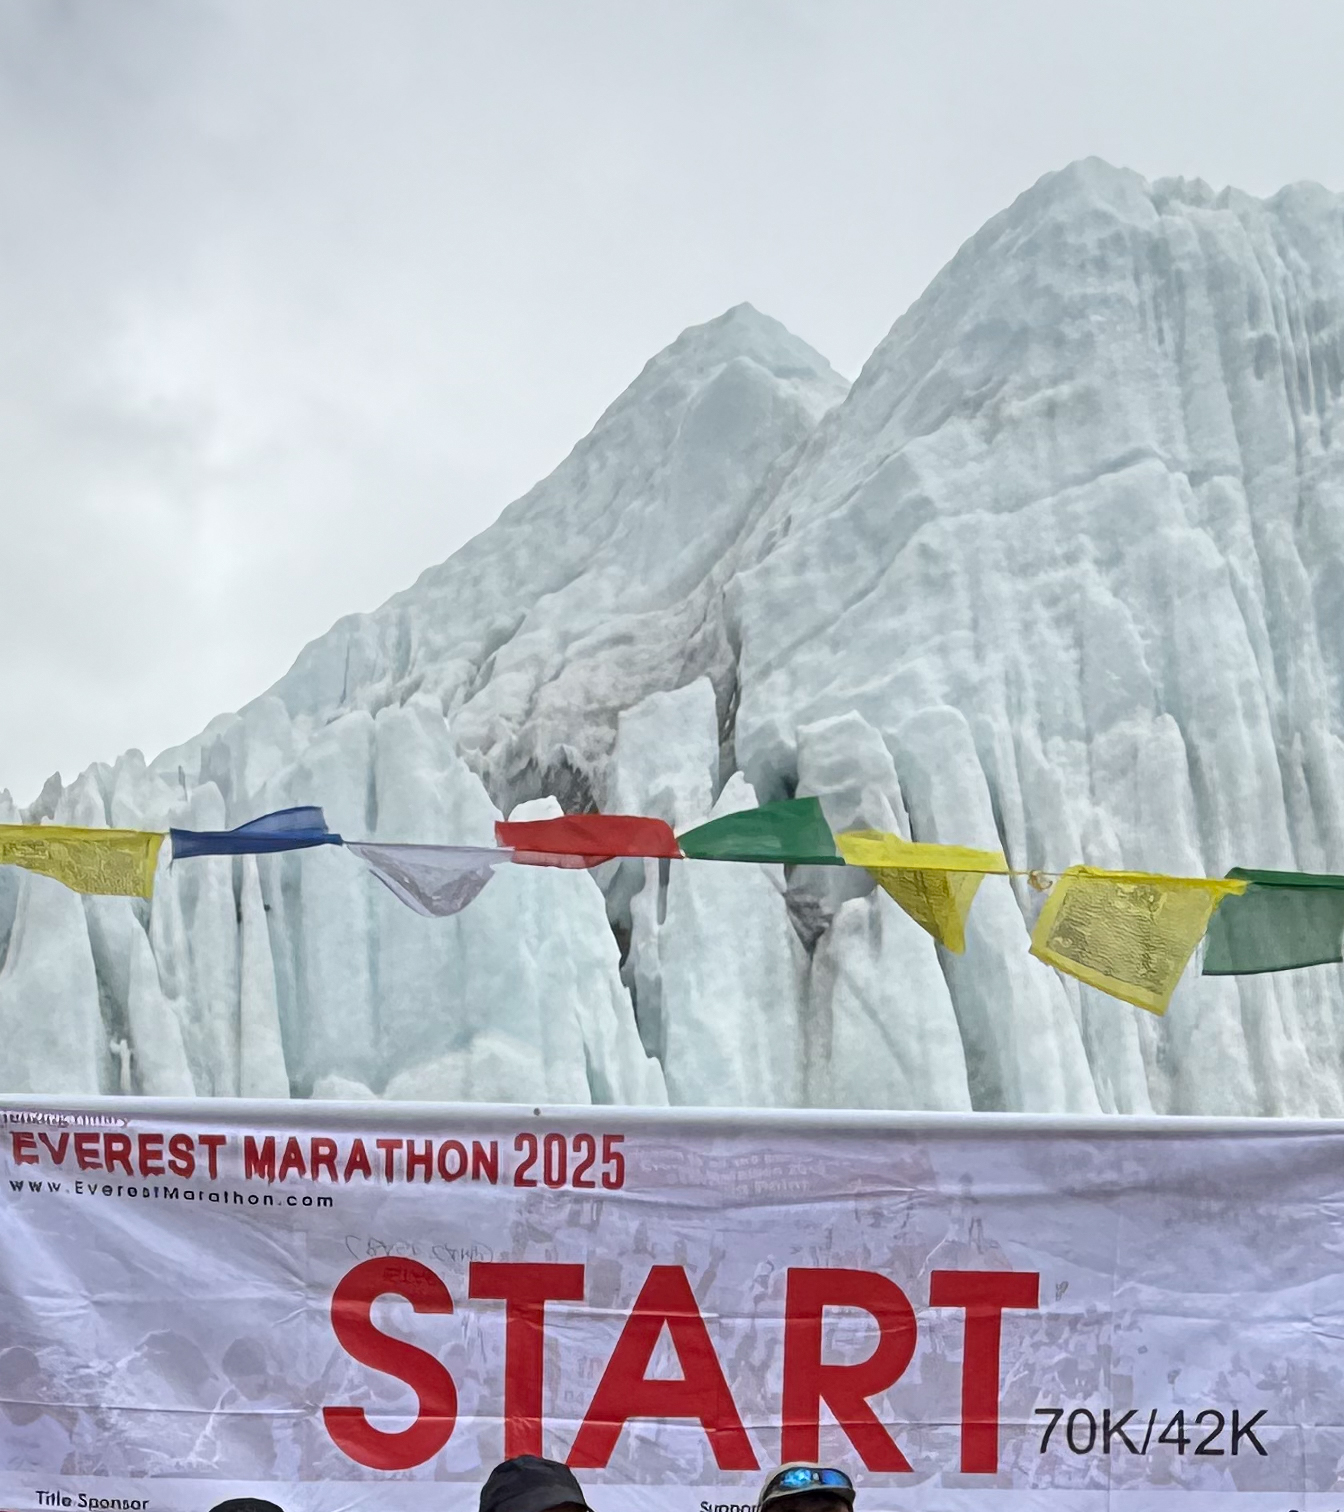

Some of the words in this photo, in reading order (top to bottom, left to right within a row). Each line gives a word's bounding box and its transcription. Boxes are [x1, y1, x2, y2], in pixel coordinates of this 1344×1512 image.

[10, 1131, 227, 1181] EVEREST
[244, 1135, 499, 1186] MARATHON
[513, 1132, 626, 1190] 2025
[322, 1255, 1041, 1475] START
[1034, 1406, 1272, 1458] 70K/42K
[36, 1489, 72, 1508] Title
[76, 1492, 150, 1512] Sponsor
